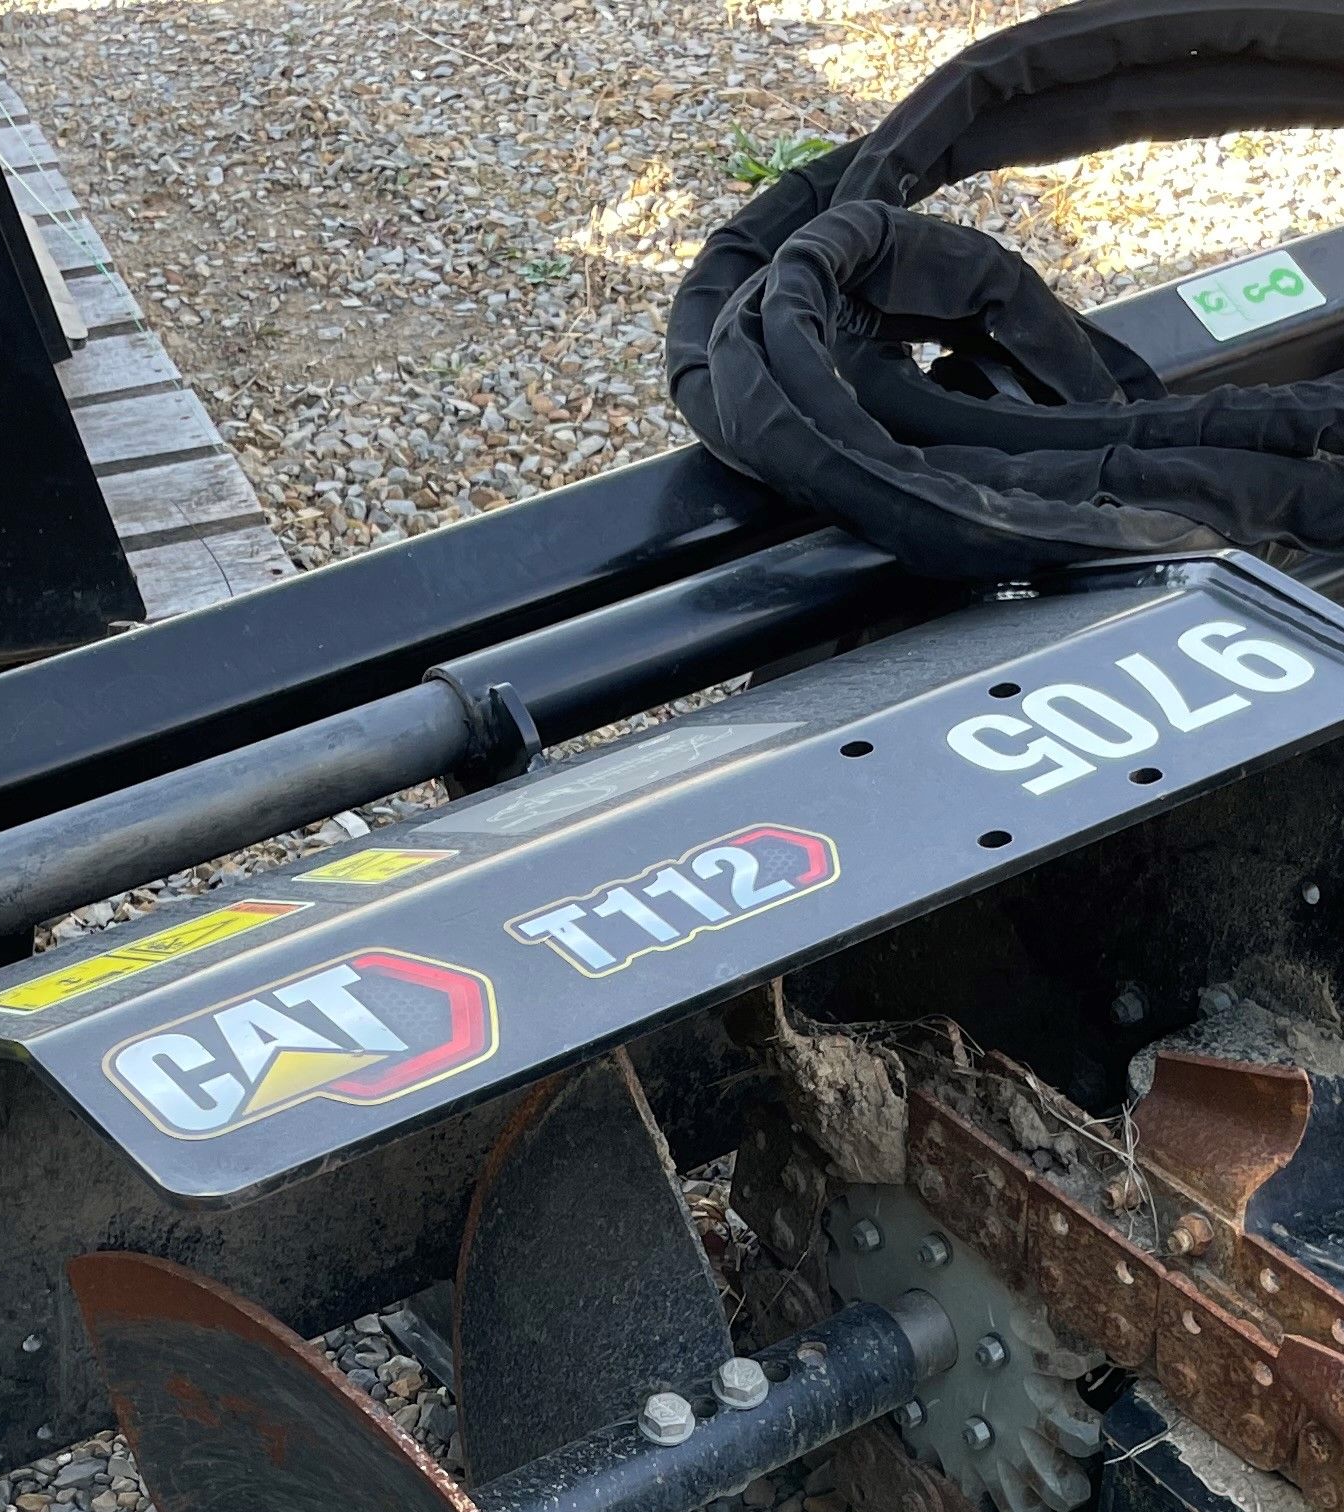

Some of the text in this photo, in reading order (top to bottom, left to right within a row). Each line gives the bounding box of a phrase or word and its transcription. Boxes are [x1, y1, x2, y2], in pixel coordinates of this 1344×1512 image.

[947, 622, 1315, 796] 9705
[518, 846, 795, 970] T112
[115, 964, 408, 1131] CAT
